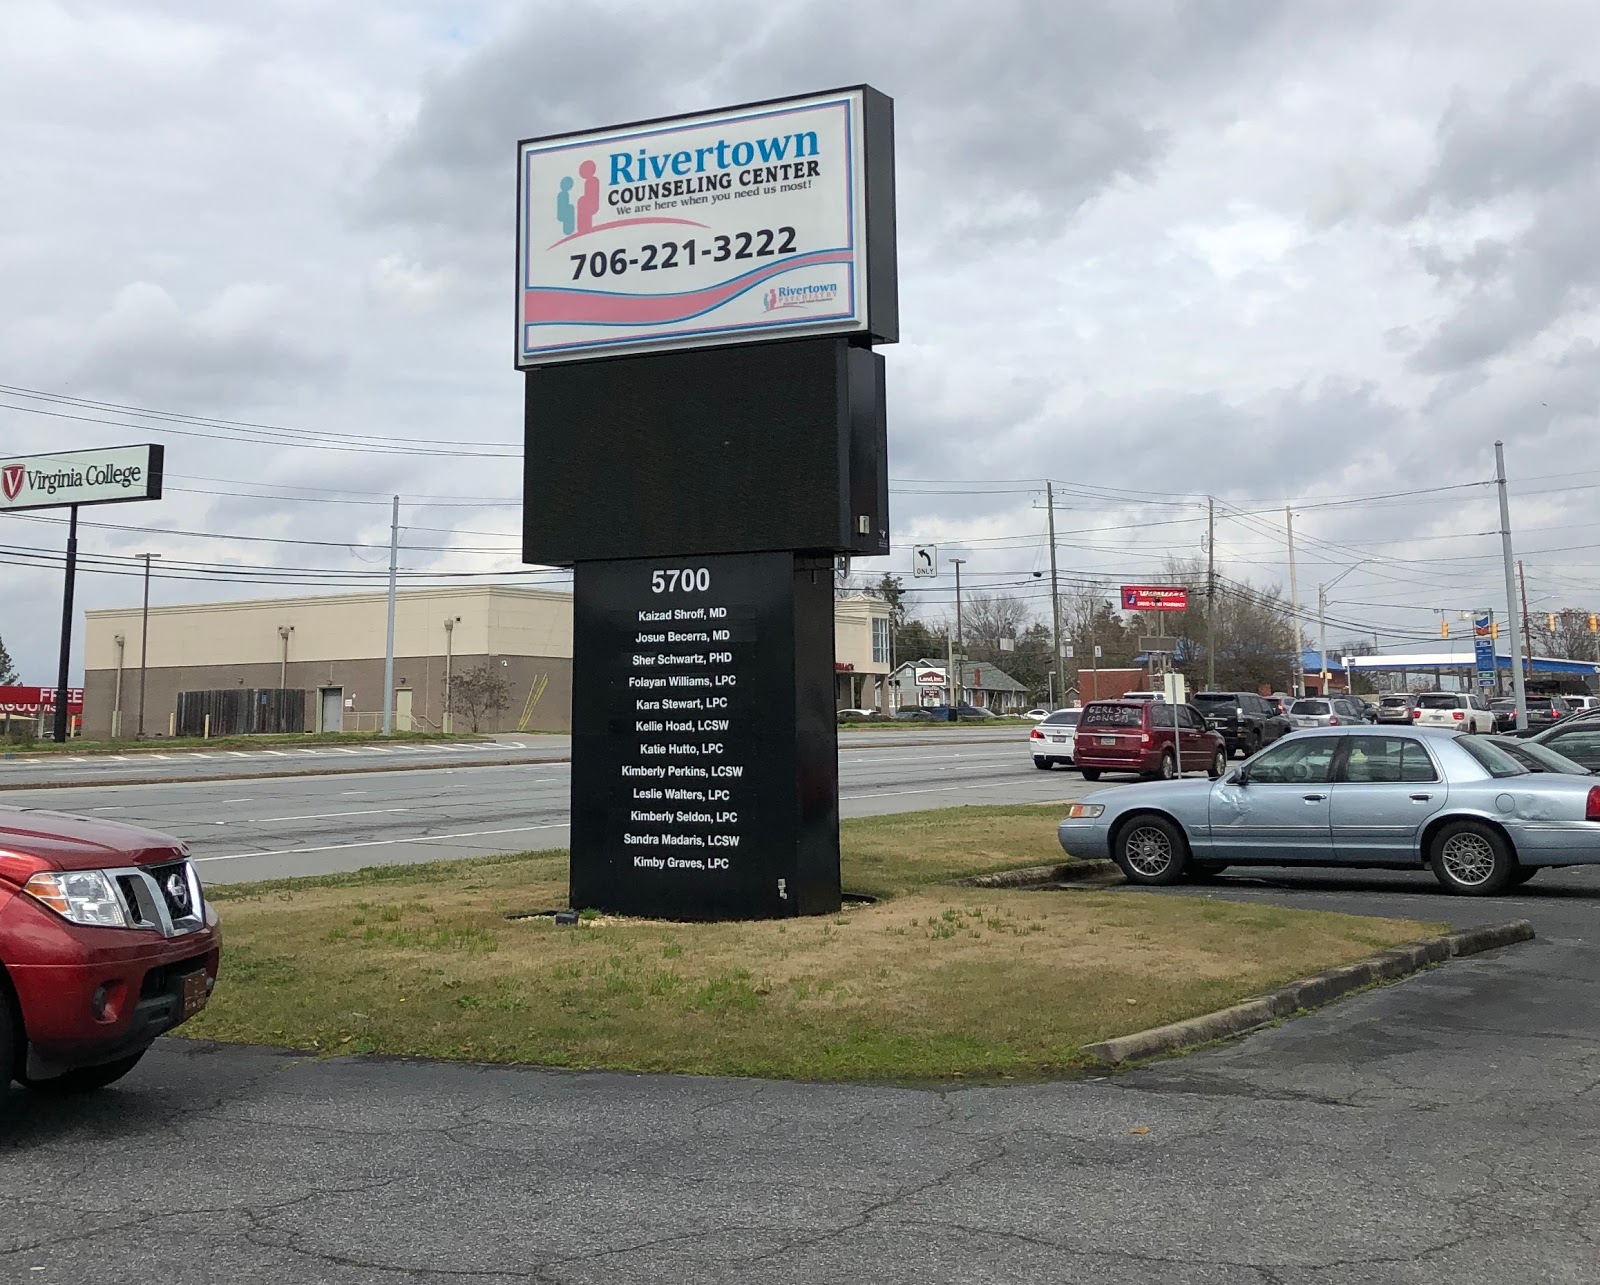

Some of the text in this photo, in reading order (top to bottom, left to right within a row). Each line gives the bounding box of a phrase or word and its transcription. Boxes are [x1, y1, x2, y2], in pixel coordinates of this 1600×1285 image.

[608, 131, 820, 186] Rivertown
[608, 160, 821, 206] COUNSELING CENTER
[616, 179, 813, 216] We are here when you need us most!
[570, 226, 797, 281] 706-221-3222
[778, 283, 837, 297] Rivertown
[27, 468, 83, 495] Virginia
[86, 463, 142, 488] College
[916, 567, 934, 575] ONLY
[651, 567, 709, 594] 5700
[638, 607, 726, 622] Kaizad Shroff, MD
[635, 629, 730, 643] Josue Becerra, MD
[632, 651, 732, 666] Sher Schwartz, PHD
[628, 674, 736, 690] Folayan Williams, LPC
[636, 696, 727, 711] Kara Stewart, LPC
[635, 719, 729, 733] Kellie Hoad, LCSW
[640, 742, 723, 756] Katie Hutto, LPC
[621, 765, 743, 779] Kimberly Perkins, LCSW
[633, 787, 729, 803] Leslie Walters, LPC
[630, 810, 737, 825] Kimberly Seldon, LPC
[623, 832, 739, 848] Sandra Madaris, LCSW
[633, 856, 728, 871] Kimby Graves, LPC
